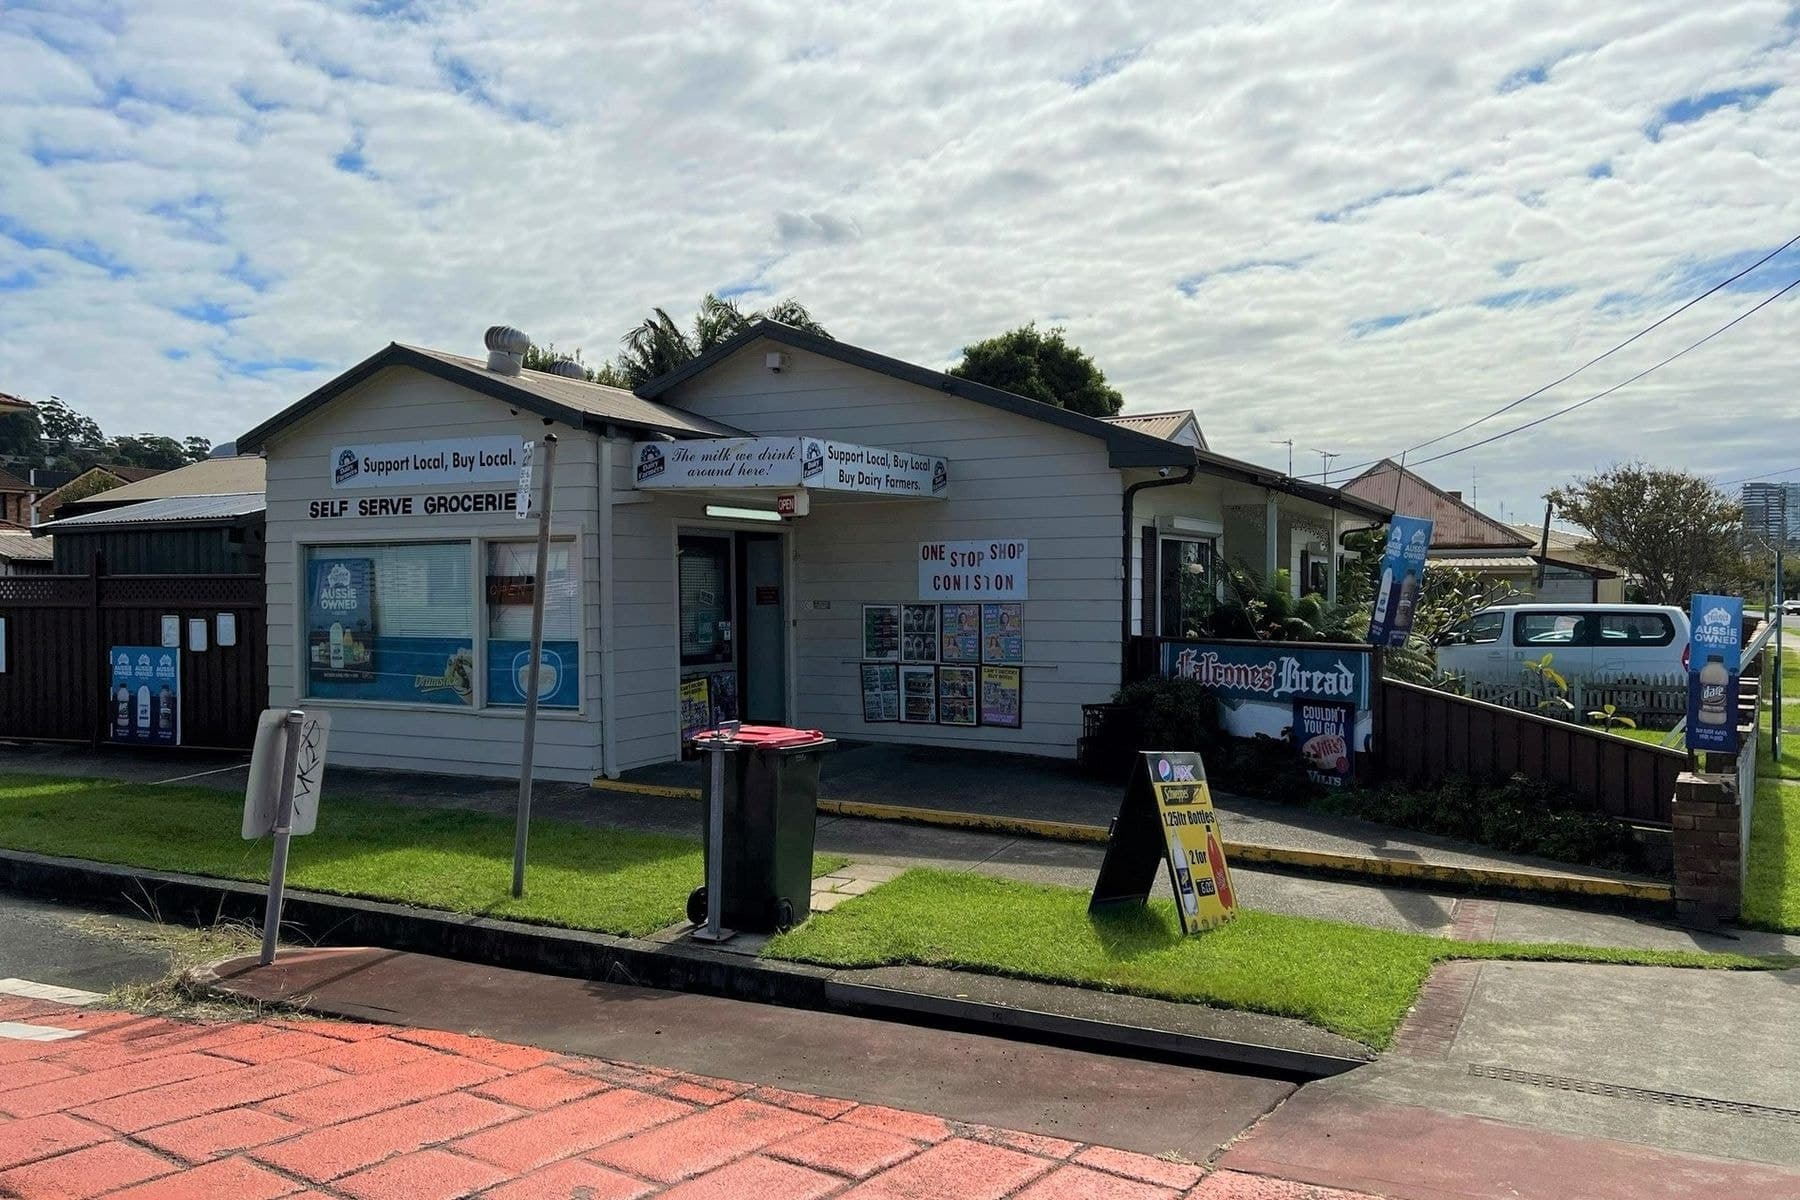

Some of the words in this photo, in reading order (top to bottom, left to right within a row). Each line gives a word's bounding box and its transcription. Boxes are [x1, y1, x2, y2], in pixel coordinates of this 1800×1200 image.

[363, 456, 410, 477] Support
[413, 451, 448, 471] Local,
[452, 453, 475, 472] Buy
[479, 448, 517, 467] Local.
[672, 446, 696, 462] The
[701, 447, 729, 461] milk
[736, 451, 754, 461] we
[758, 446, 795, 461] drink
[827, 445, 863, 466] Support
[866, 450, 891, 469] Local,
[893, 451, 911, 471] Buy
[911, 454, 930, 472] Local
[687, 462, 732, 478] around
[738, 462, 773, 477] here!
[838, 472, 856, 490] Buy
[858, 473, 881, 489] Dairy
[885, 474, 921, 490] Farmers.
[309, 500, 348, 518] SELF
[358, 497, 413, 516] SERVE
[778, 499, 794, 511] OPEN
[922, 544, 945, 561] ONE
[950, 552, 984, 567] STOP
[990, 543, 1025, 560] SHOP
[933, 574, 1014, 591] CONISTON
[321, 599, 357, 610] OWNED
[1695, 633, 1738, 645] OWNED
[1273, 656, 1355, 698] Bread
[1703, 685, 1724, 698] dare
[1303, 705, 1346, 723] COULDN'T
[1304, 719, 1322, 734] YOU
[1324, 721, 1336, 737] GO
[1338, 723, 1345, 738] A
[1187, 809, 1215, 825] Bottles
[1189, 849, 1196, 865] 2
[1195, 849, 1207, 864] for
